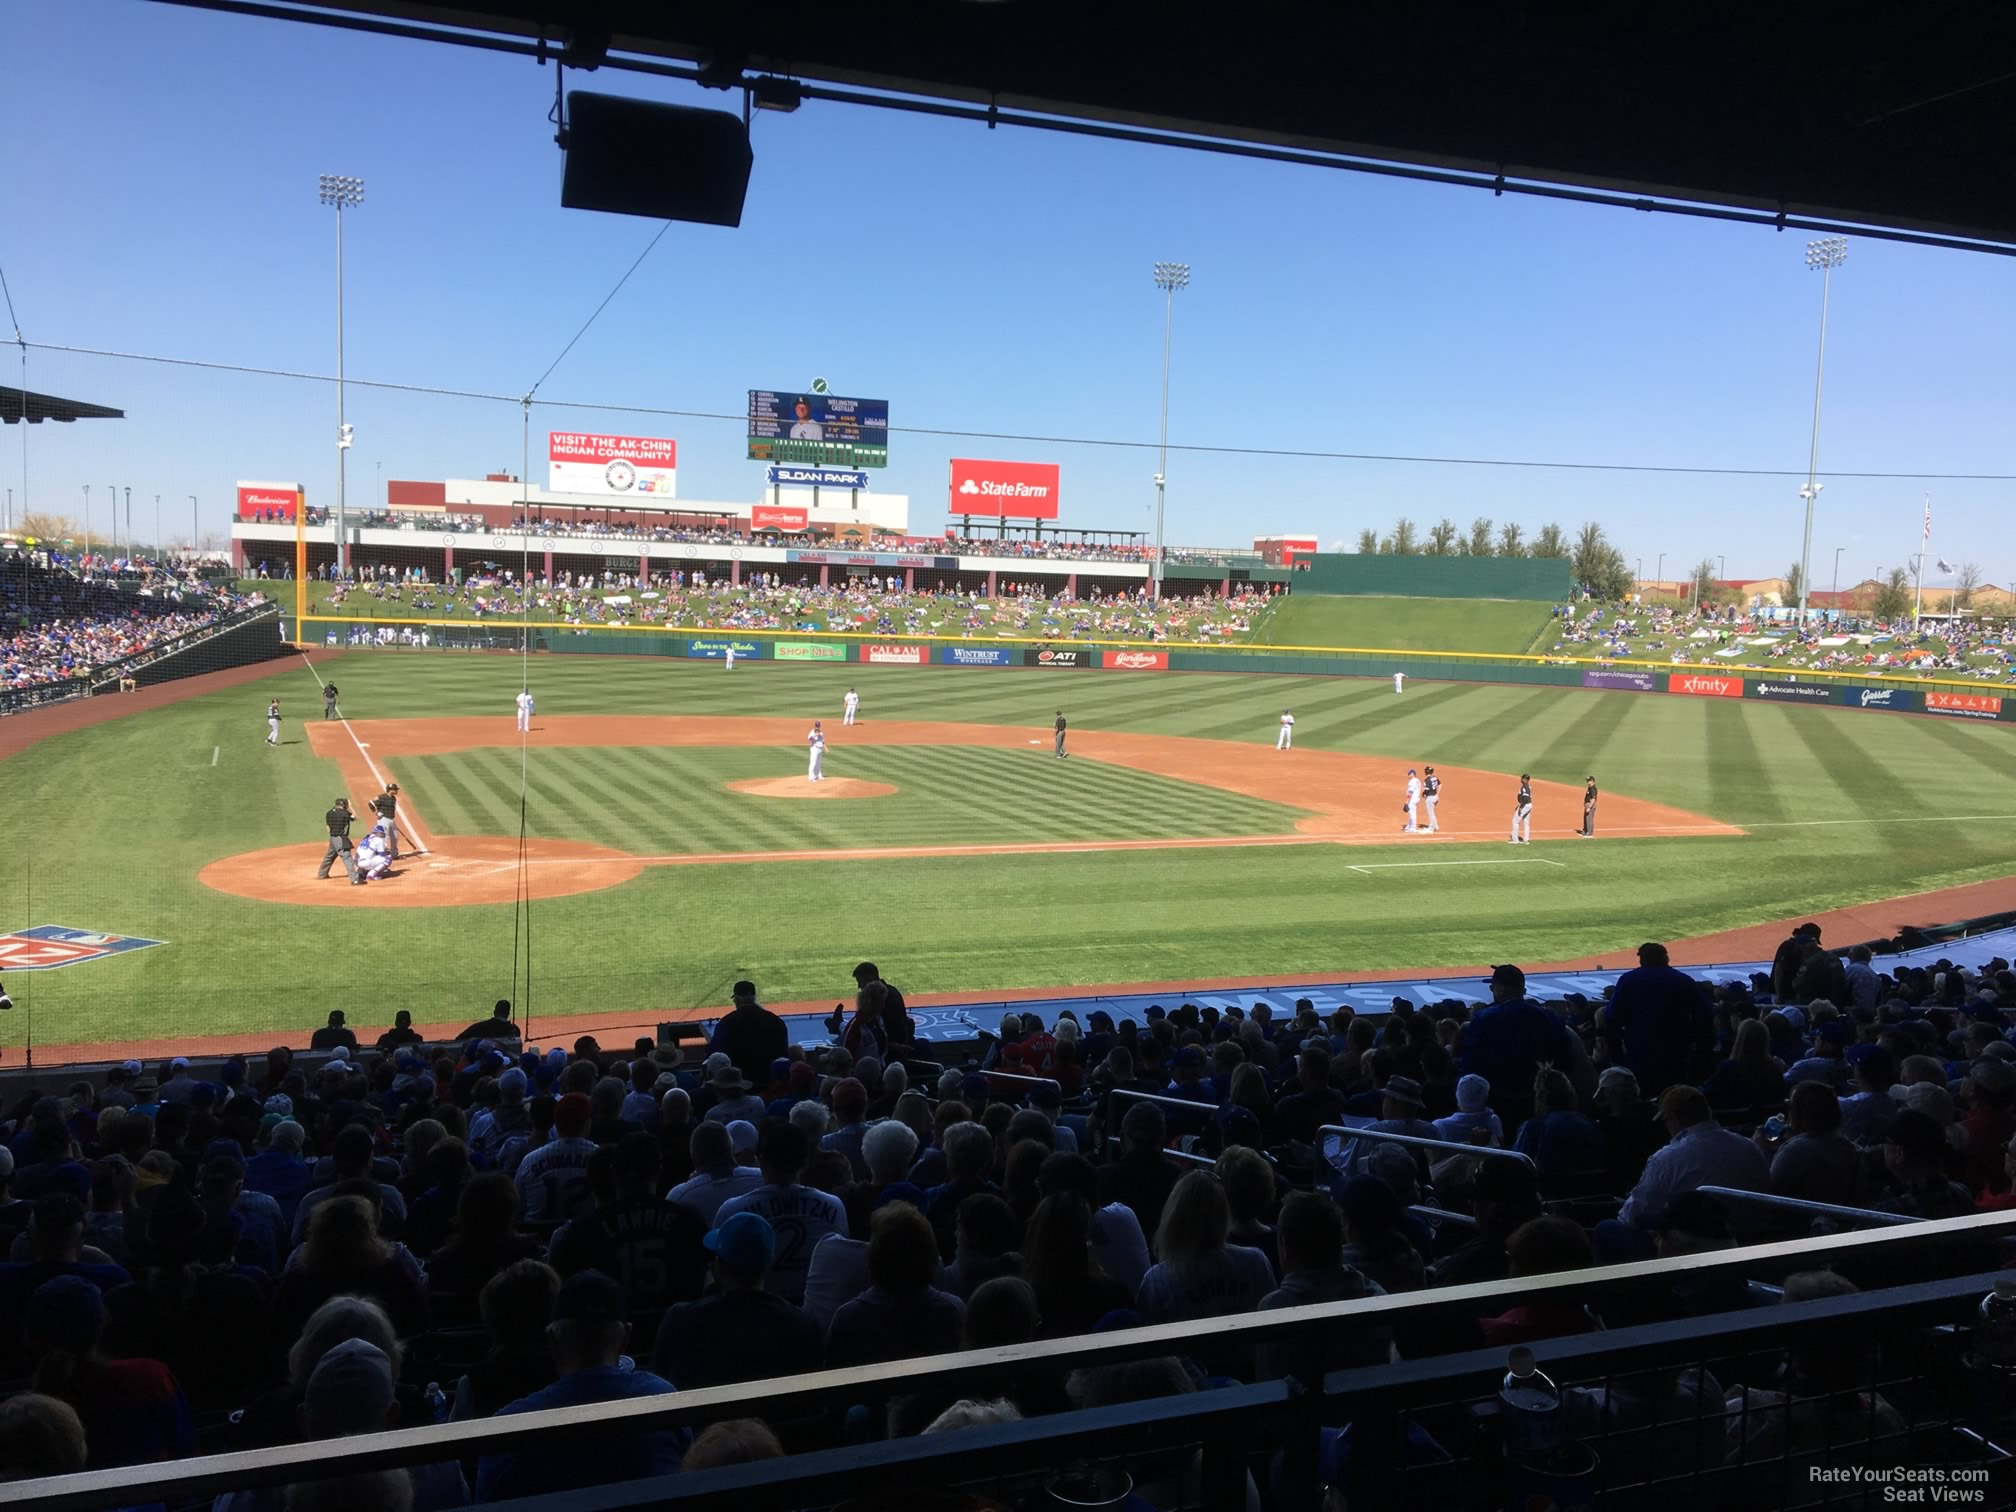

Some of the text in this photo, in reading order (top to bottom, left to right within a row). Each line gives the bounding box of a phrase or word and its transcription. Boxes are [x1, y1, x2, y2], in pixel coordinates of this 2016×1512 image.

[828, 399, 858, 407] WELINGTON
[553, 434, 672, 450] VISIT THE AK-CHIN
[553, 445, 672, 460] INDIAN COMMUNITY
[778, 470, 858, 484] SLOAN PARK
[245, 494, 290, 504] Budweiser
[606, 557, 640, 568] BURGE
[692, 640, 712, 650] Save
[779, 647, 842, 657] SHOP MESA
[870, 646, 920, 655] CAL AM
[954, 649, 999, 659] WINTRUST
[1054, 652, 1077, 661] ATI
[1683, 677, 1729, 695] xfinity
[1768, 685, 1830, 696] Advocate Health Care
[1861, 689, 1894, 706] Garrett
[1194, 984, 1483, 1014] MESA
[1040, 1053, 1052, 1072] 4
[528, 1153, 590, 1175] SCHWAR
[544, 1176, 588, 1218] 12
[601, 1208, 673, 1239] LAWRIE
[771, 1218, 808, 1270] 2
[616, 1238, 667, 1295] 15
